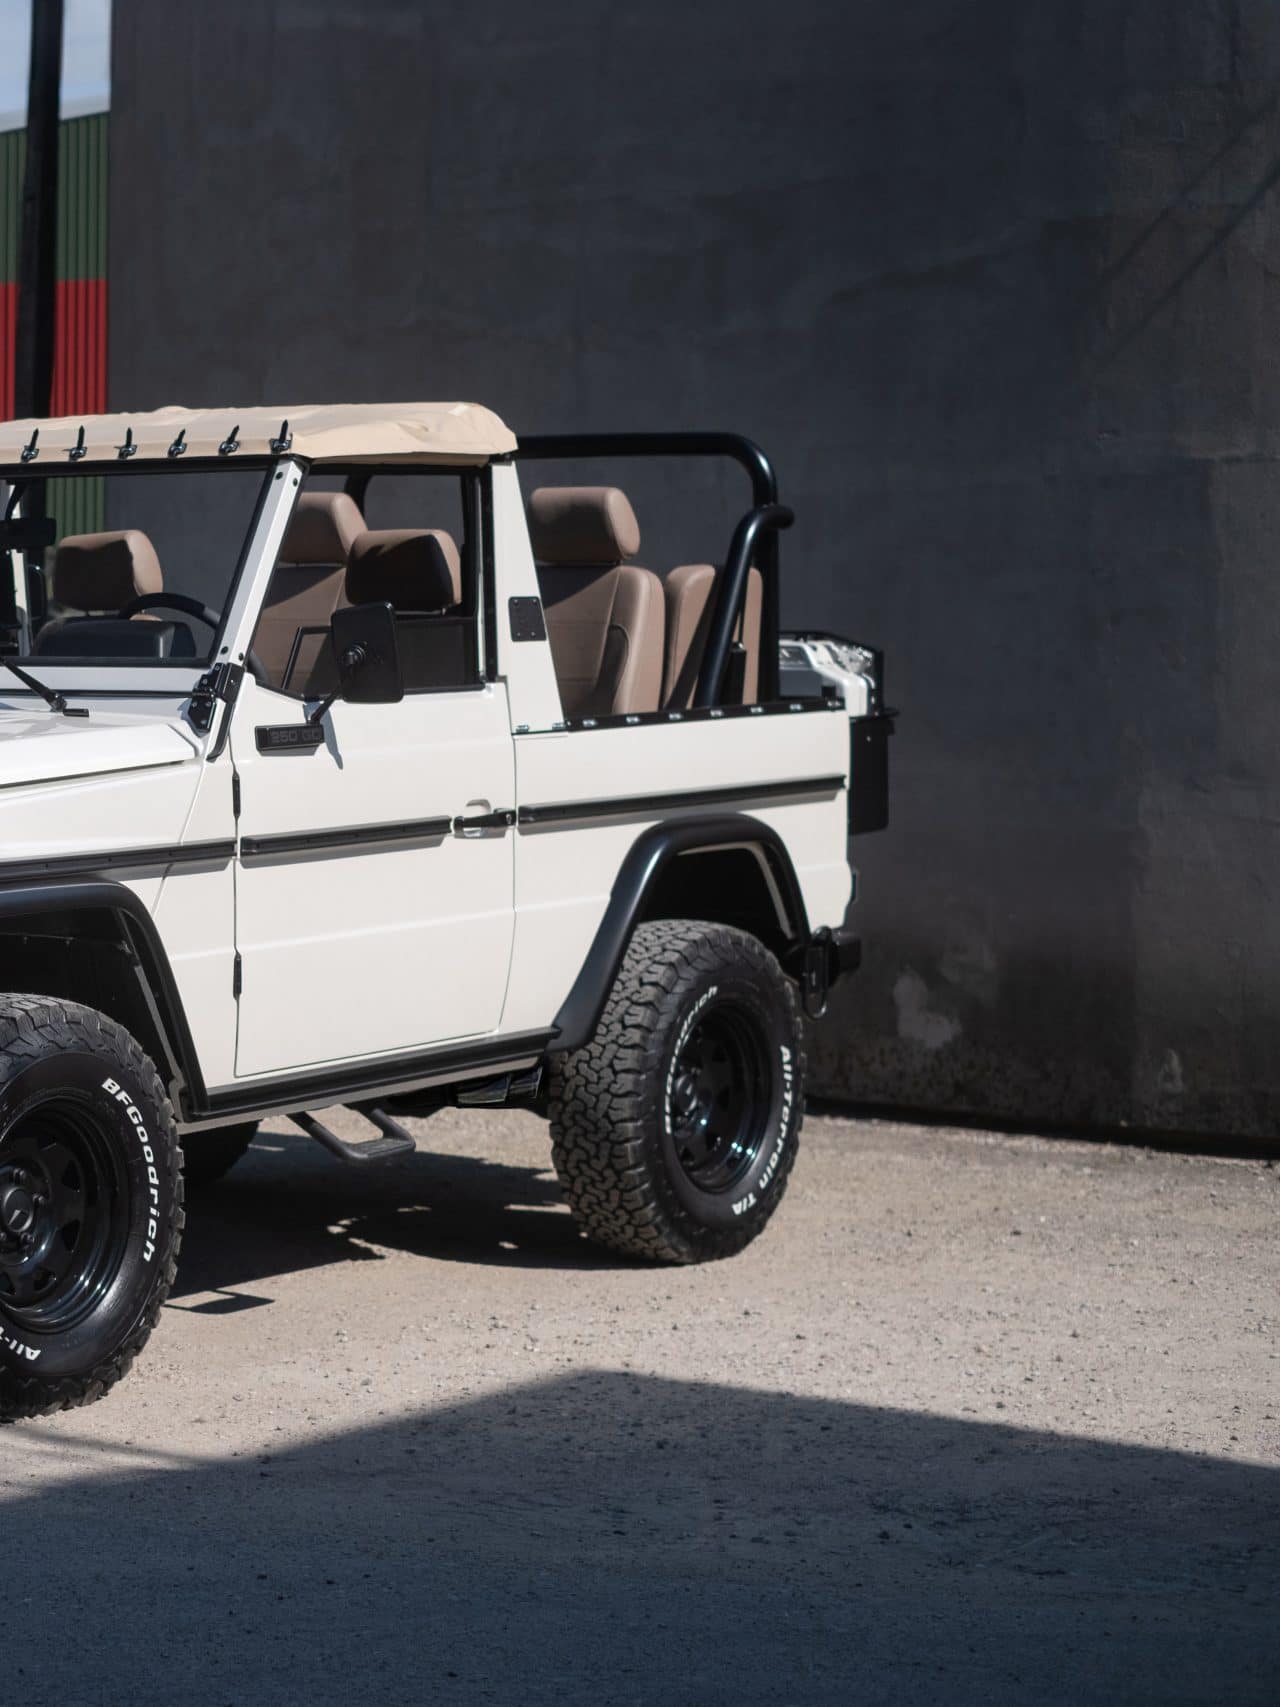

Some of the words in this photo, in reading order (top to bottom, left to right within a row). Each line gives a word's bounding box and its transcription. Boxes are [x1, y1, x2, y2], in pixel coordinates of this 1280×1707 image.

[101, 1077, 160, 1262] BFGoodrich
[759, 1045, 793, 1189] All-Terrain
[731, 1192, 757, 1216] T/A
